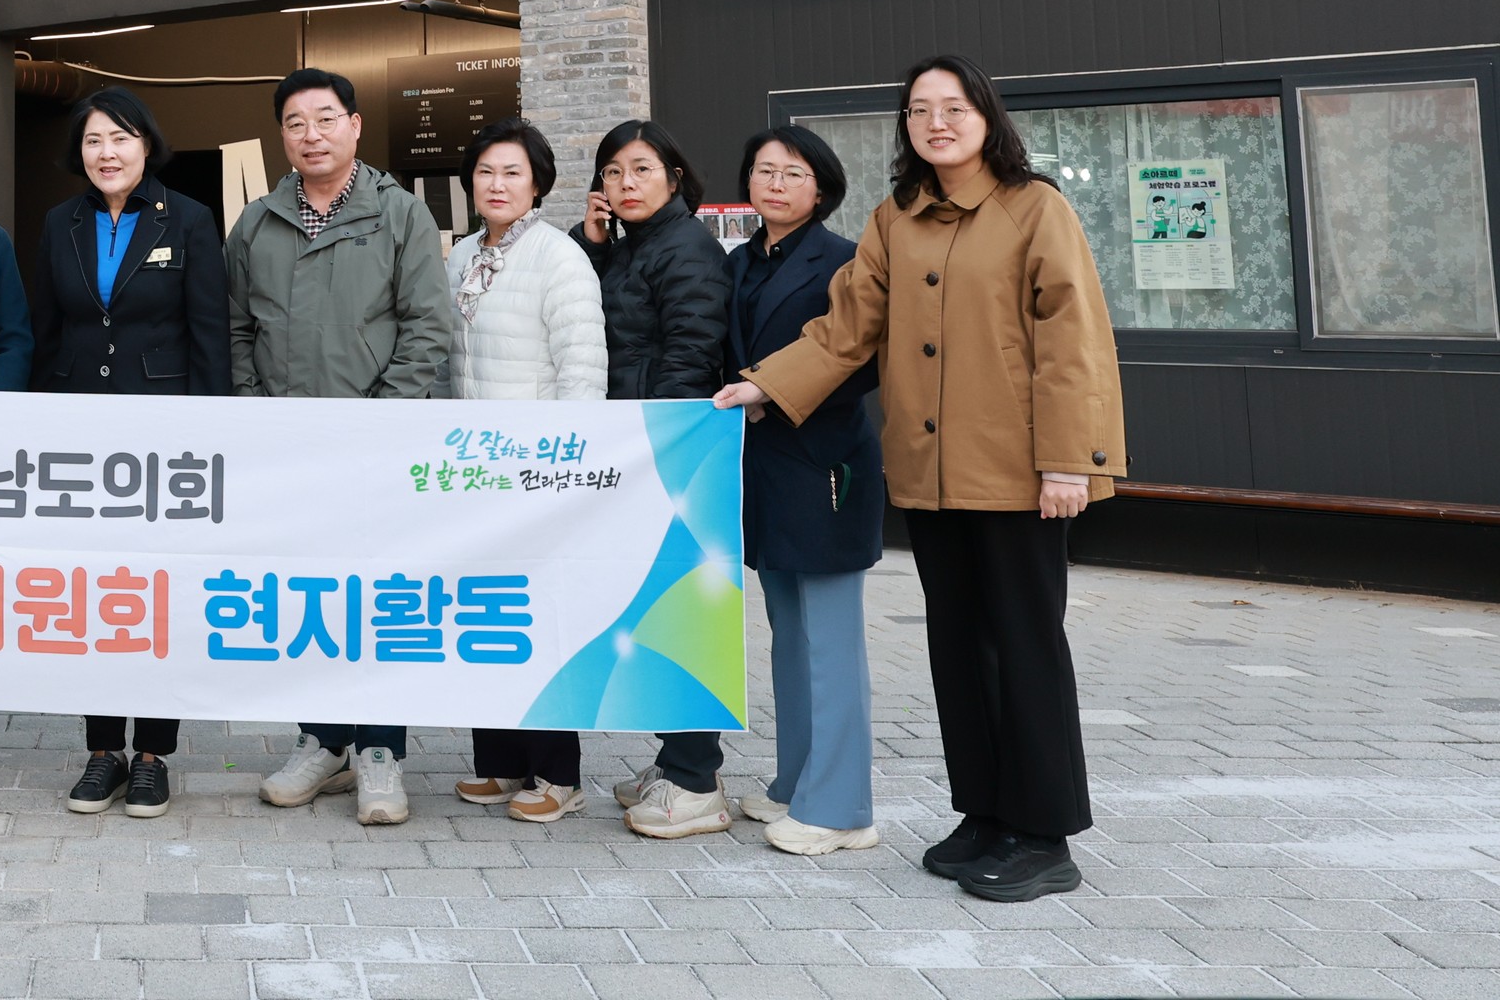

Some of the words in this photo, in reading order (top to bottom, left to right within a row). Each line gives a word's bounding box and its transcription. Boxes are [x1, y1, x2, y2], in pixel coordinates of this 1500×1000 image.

[456, 60, 488, 71] TICKET
[421, 88, 445, 96] Admission
[445, 86, 455, 94] Fee
[1183, 180, 1217, 189] 프로그램
[444, 428, 478, 460] 일
[479, 430, 531, 461] 잘하는
[536, 432, 587, 464] 의회
[462, 464, 514, 491] 맛나는
[519, 466, 622, 493] 전라남도의회
[203, 569, 533, 665] 현지활동
